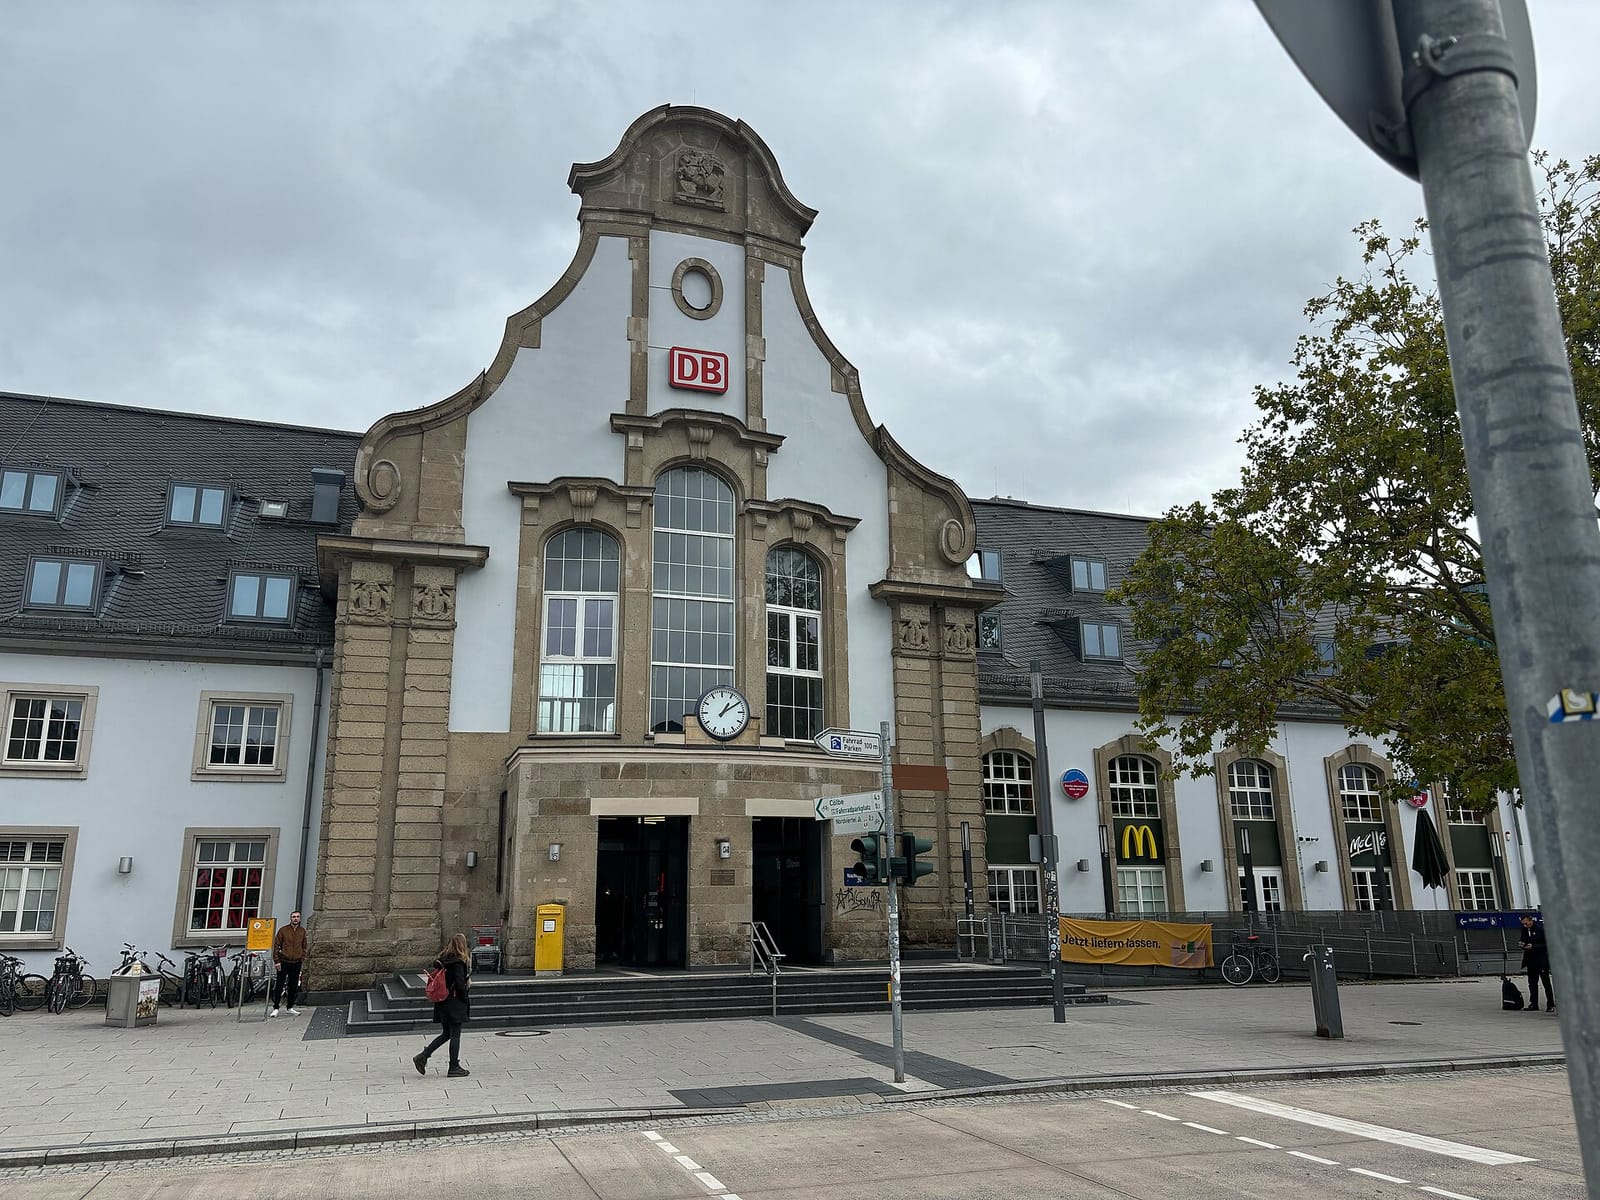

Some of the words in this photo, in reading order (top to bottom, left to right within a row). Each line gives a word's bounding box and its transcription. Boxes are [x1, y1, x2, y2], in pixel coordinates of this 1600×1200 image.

[678, 353, 721, 384] DB
[842, 736, 863, 745] Fahrrad
[864, 742, 873, 750] 100
[843, 743, 862, 752] Parken
[829, 799, 845, 807] Cölbe
[197, 869, 260, 887] ASIA
[210, 889, 244, 907] DO
[1062, 934, 1090, 947] Jetzt
[1091, 937, 1124, 949] liefern
[1126, 938, 1161, 949] lassen.
